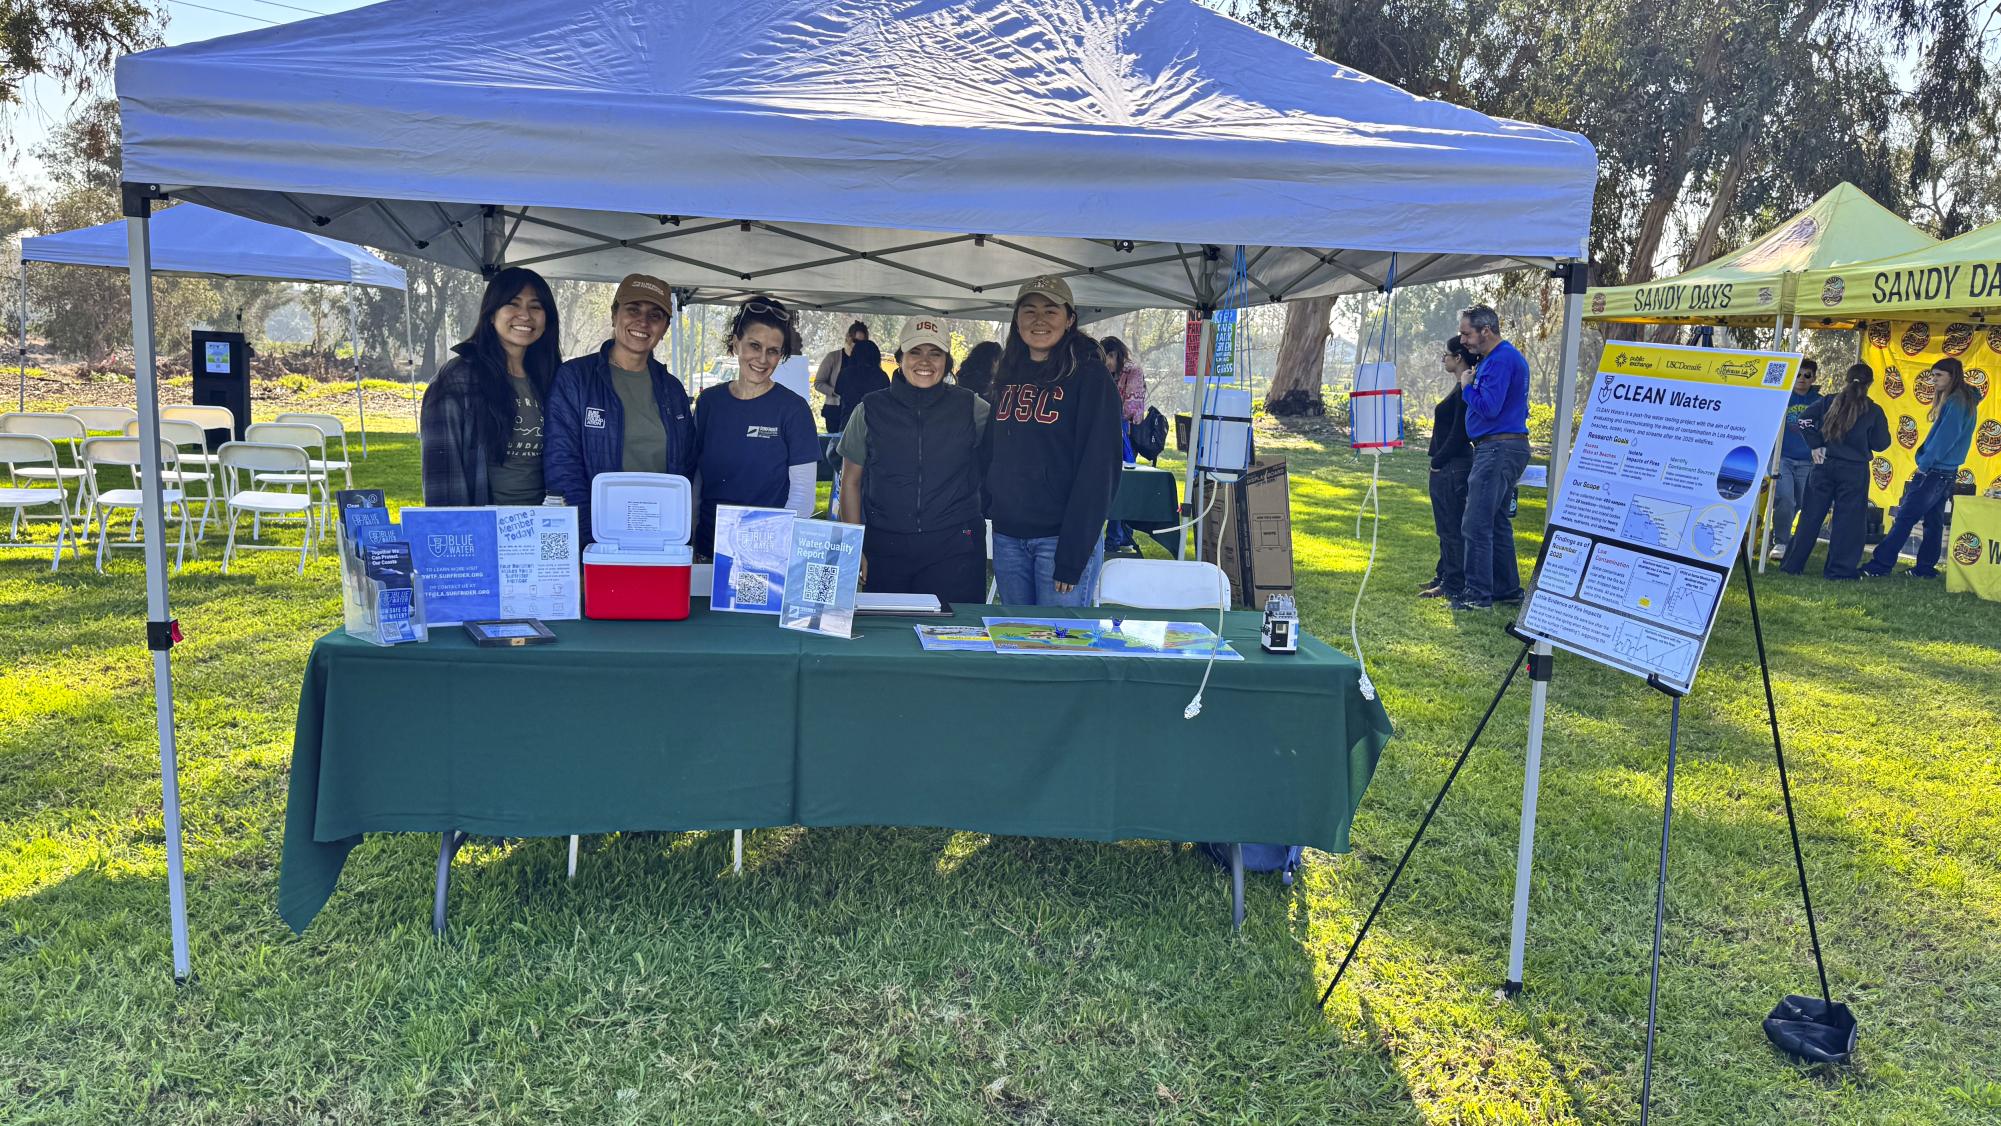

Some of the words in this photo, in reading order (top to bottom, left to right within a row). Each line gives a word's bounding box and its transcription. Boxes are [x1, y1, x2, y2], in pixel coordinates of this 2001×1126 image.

[1872, 265, 1960, 304] SANDY
[1634, 285, 1686, 312] SANDY
[1688, 284, 1733, 310] DAYS
[916, 322, 938, 334] USC
[996, 384, 1064, 424] USC
[1614, 384, 1666, 404] CLEAN
[1670, 391, 1722, 412] Waters
[1588, 432, 1612, 442] Research
[1614, 436, 1629, 444] Goals
[1583, 481, 1600, 491] Scope
[499, 511, 527, 525] ecome
[499, 518, 534, 534] Member
[505, 527, 535, 541] Today!
[753, 531, 775, 541] BLUE
[1555, 535, 1575, 545] Findings
[448, 535, 474, 546] BLUE
[754, 542, 775, 550] WATER
[799, 538, 823, 549] Water
[825, 540, 853, 554] Quality
[798, 548, 825, 560] Report
[1552, 542, 1578, 554] November
